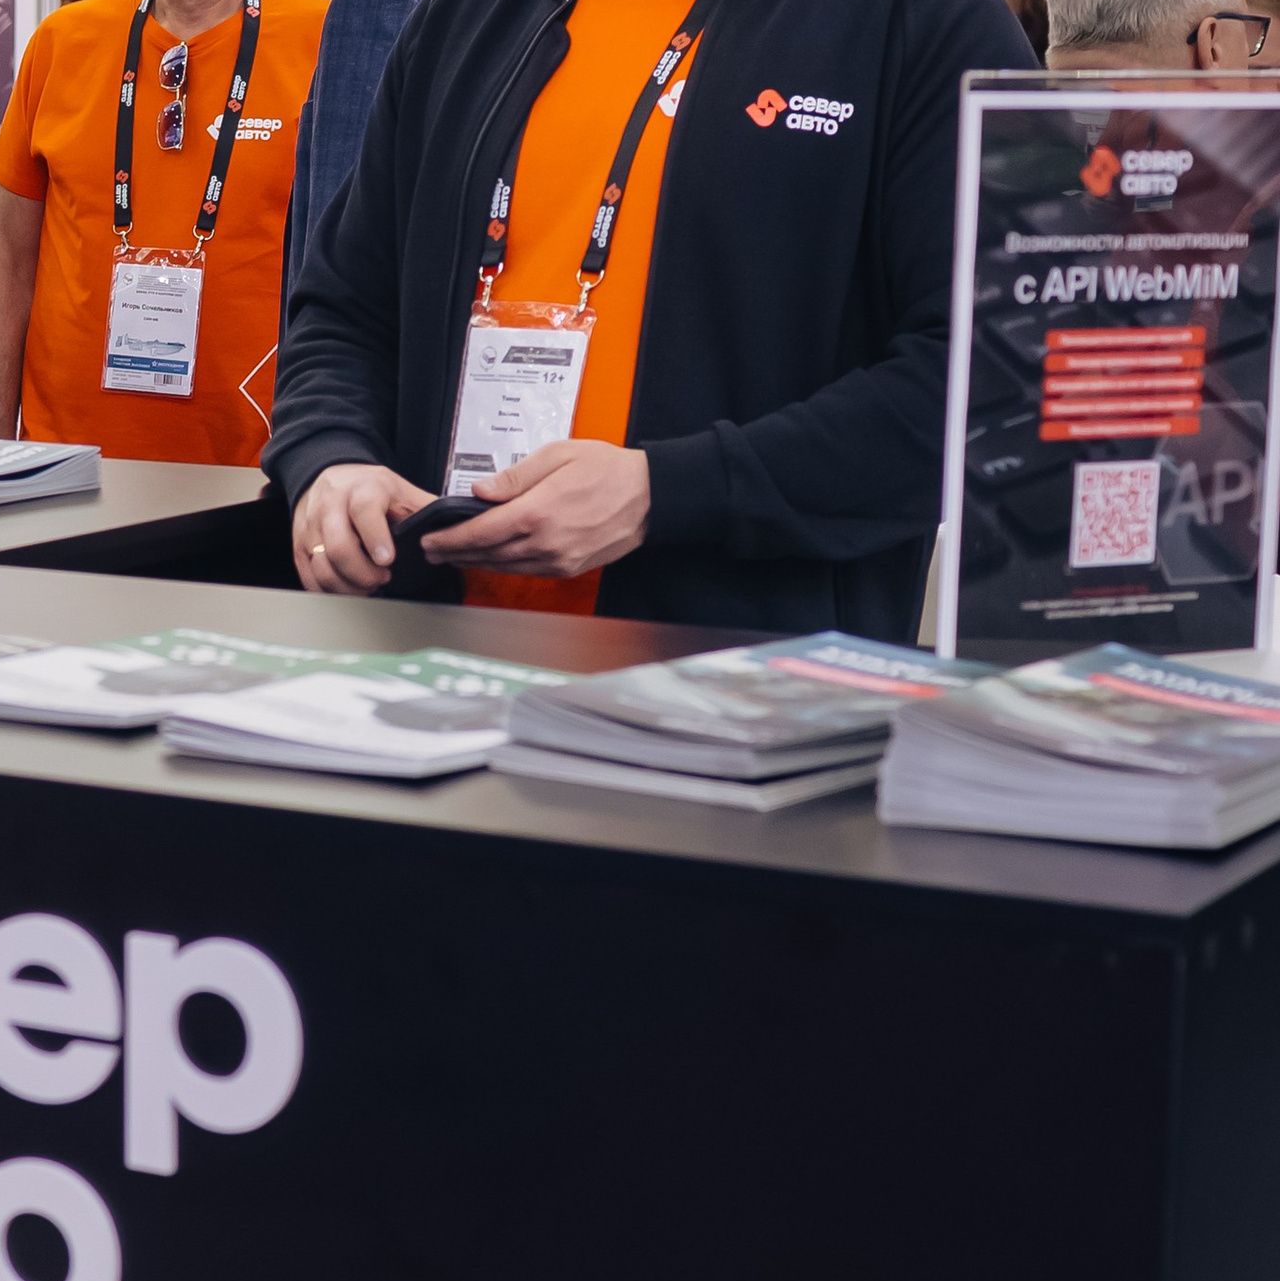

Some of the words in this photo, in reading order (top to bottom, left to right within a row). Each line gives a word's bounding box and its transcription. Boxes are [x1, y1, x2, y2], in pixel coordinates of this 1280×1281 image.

[653, 50, 673, 79] авто
[657, 51, 682, 86] север
[788, 94, 855, 120] север
[235, 130, 271, 141] авто
[238, 117, 283, 135] север
[785, 113, 839, 136] авто
[499, 185, 511, 218] авто
[592, 206, 606, 239] авто
[597, 206, 615, 248] север
[1040, 265, 1099, 303] API
[1103, 263, 1240, 302] WebMiM
[542, 372, 565, 384] 12+
